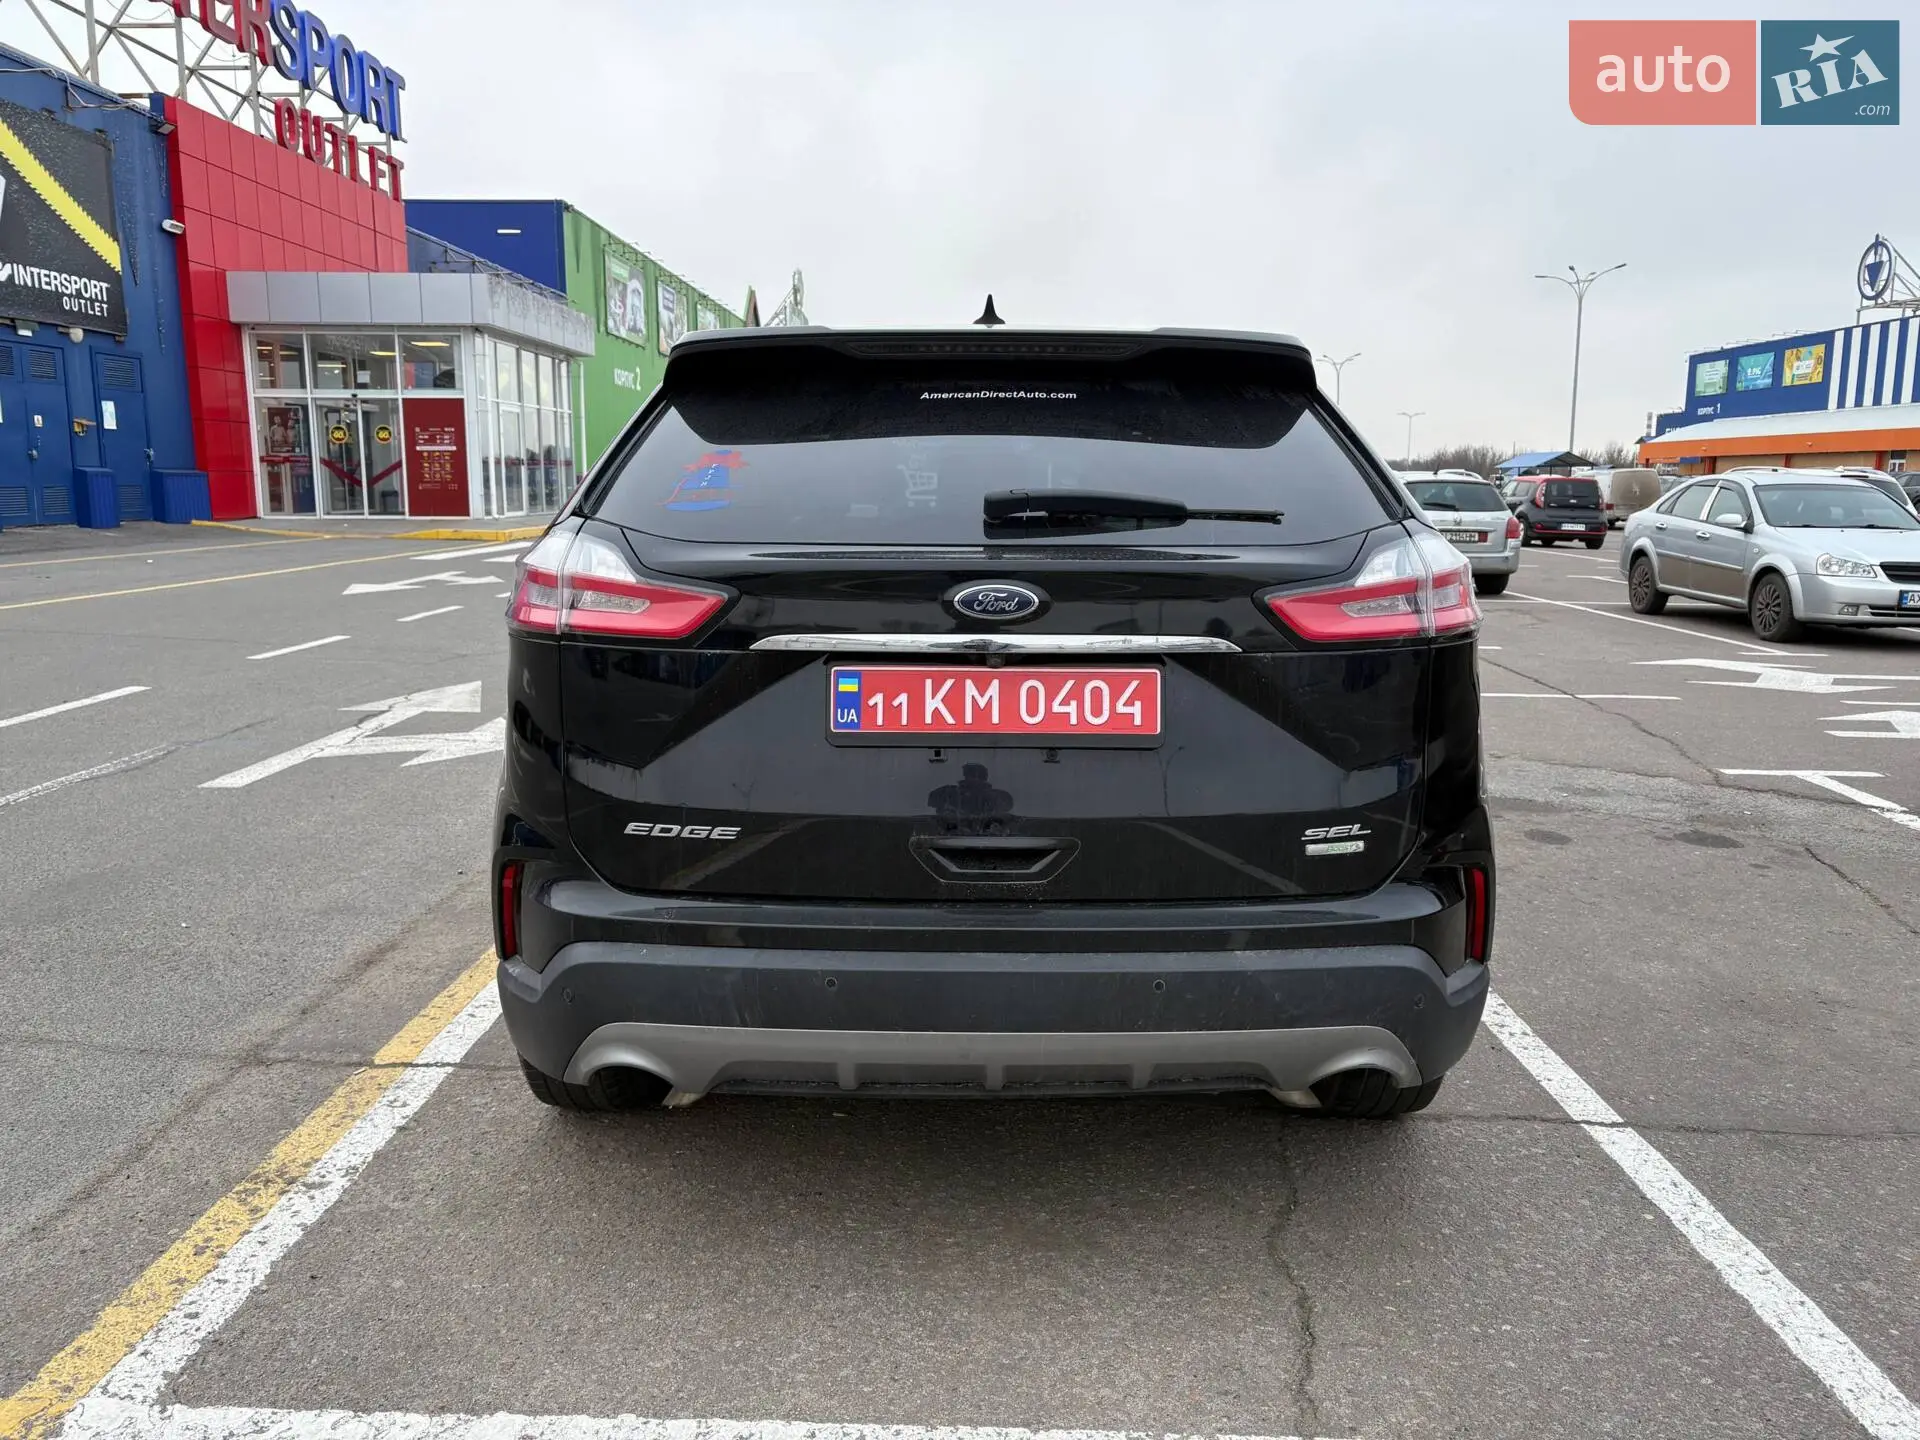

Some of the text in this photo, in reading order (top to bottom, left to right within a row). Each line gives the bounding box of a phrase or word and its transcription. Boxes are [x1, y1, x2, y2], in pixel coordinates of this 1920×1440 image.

[172, 0, 406, 141] ERSPORT
[274, 98, 404, 200] OUTLET
[13, 262, 111, 302] INTERSPORT
[62, 296, 108, 318] OUTLET
[635, 366, 641, 391] 2
[919, 389, 1078, 400] AmericanDirectAuto.com
[973, 591, 1020, 611] Ford
[837, 678, 1143, 727] UA 11 KM 0404
[623, 822, 742, 840] EDGE
[1300, 823, 1372, 840] SEL
